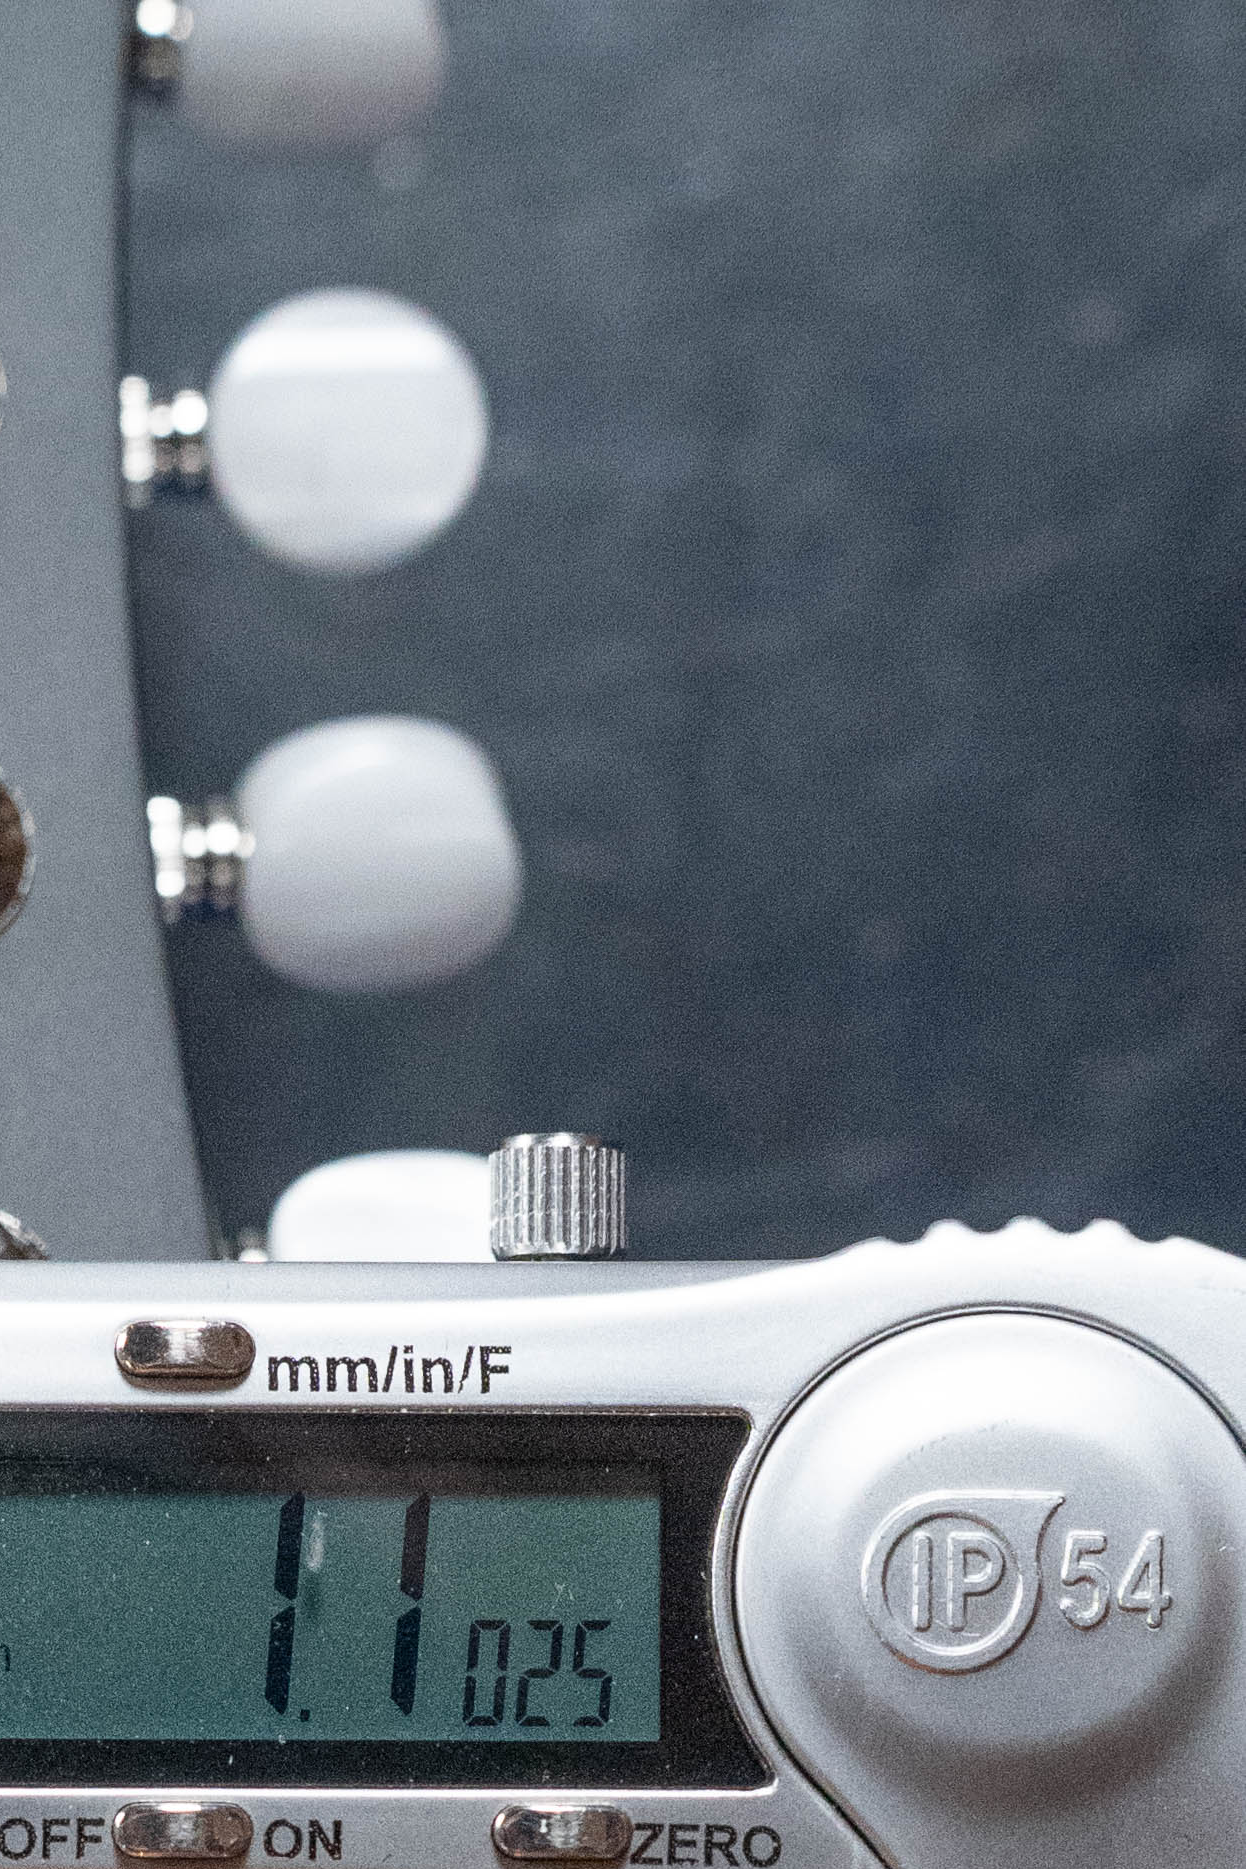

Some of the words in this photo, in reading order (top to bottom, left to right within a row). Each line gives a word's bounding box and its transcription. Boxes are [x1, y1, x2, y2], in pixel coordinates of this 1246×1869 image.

[267, 1344, 512, 1395] mm/in/F
[911, 1529, 1008, 1633] IP
[1059, 1529, 1174, 1632] 54
[262, 1818, 344, 1862] ON
[627, 1820, 783, 1869] ZERO
